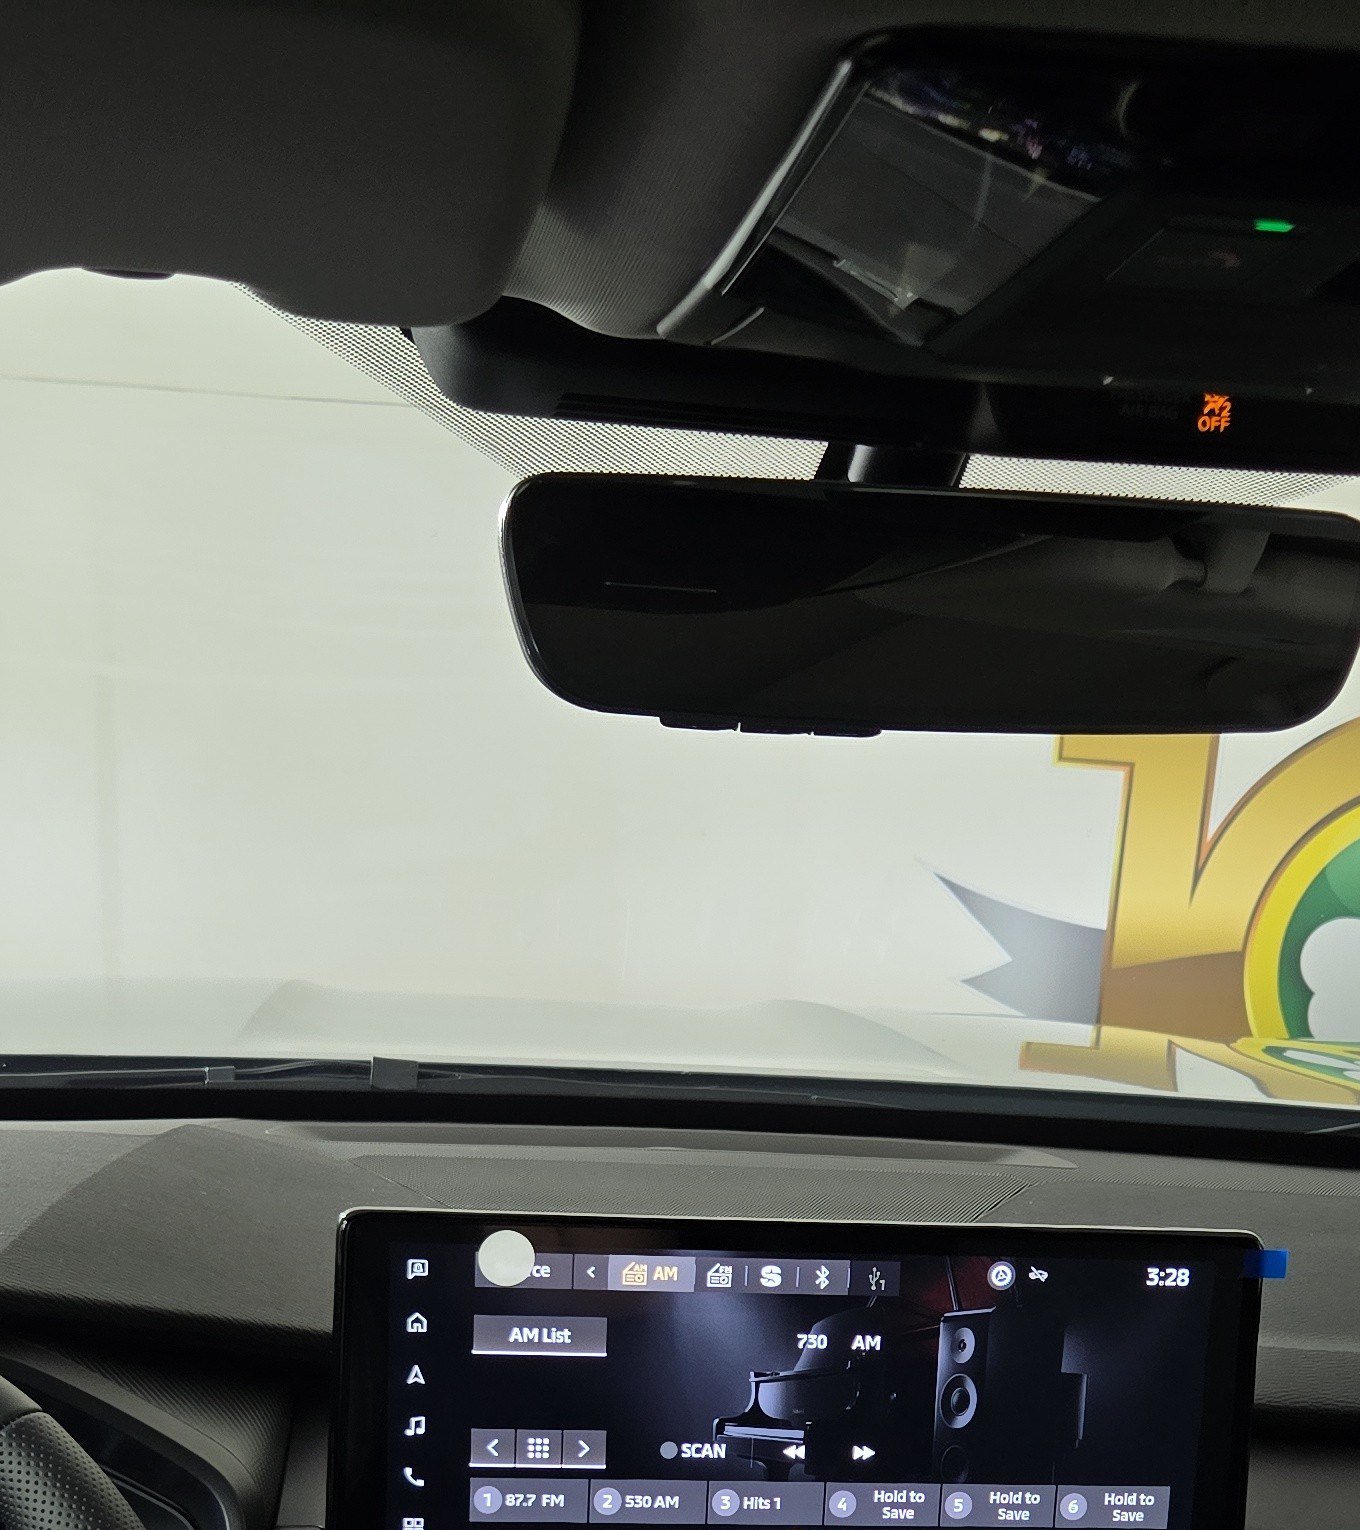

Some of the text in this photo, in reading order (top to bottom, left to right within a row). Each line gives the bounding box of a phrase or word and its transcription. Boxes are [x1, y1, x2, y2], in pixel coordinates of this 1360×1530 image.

[1197, 416, 1231, 432] OFF
[653, 1266, 678, 1281] AM
[1146, 1268, 1190, 1286] 3:28
[508, 1328, 572, 1344] AM List
[797, 1334, 881, 1350] 730 AM
[680, 1443, 726, 1459] SCAN
[482, 1494, 565, 1507] 1 87.7 FM
[602, 1495, 680, 1509] 2 530 AM
[873, 1490, 926, 1503] Hold to
[989, 1492, 1041, 1505] Hold to
[1104, 1493, 1155, 1506] Hold to
[720, 1497, 781, 1510] 3 Hits 1
[837, 1498, 848, 1511] 4
[954, 1499, 963, 1512] 5
[1068, 1500, 1079, 1513] 6
[882, 1507, 915, 1520] Save
[997, 1508, 1030, 1521] Save
[1112, 1509, 1144, 1522] Save
